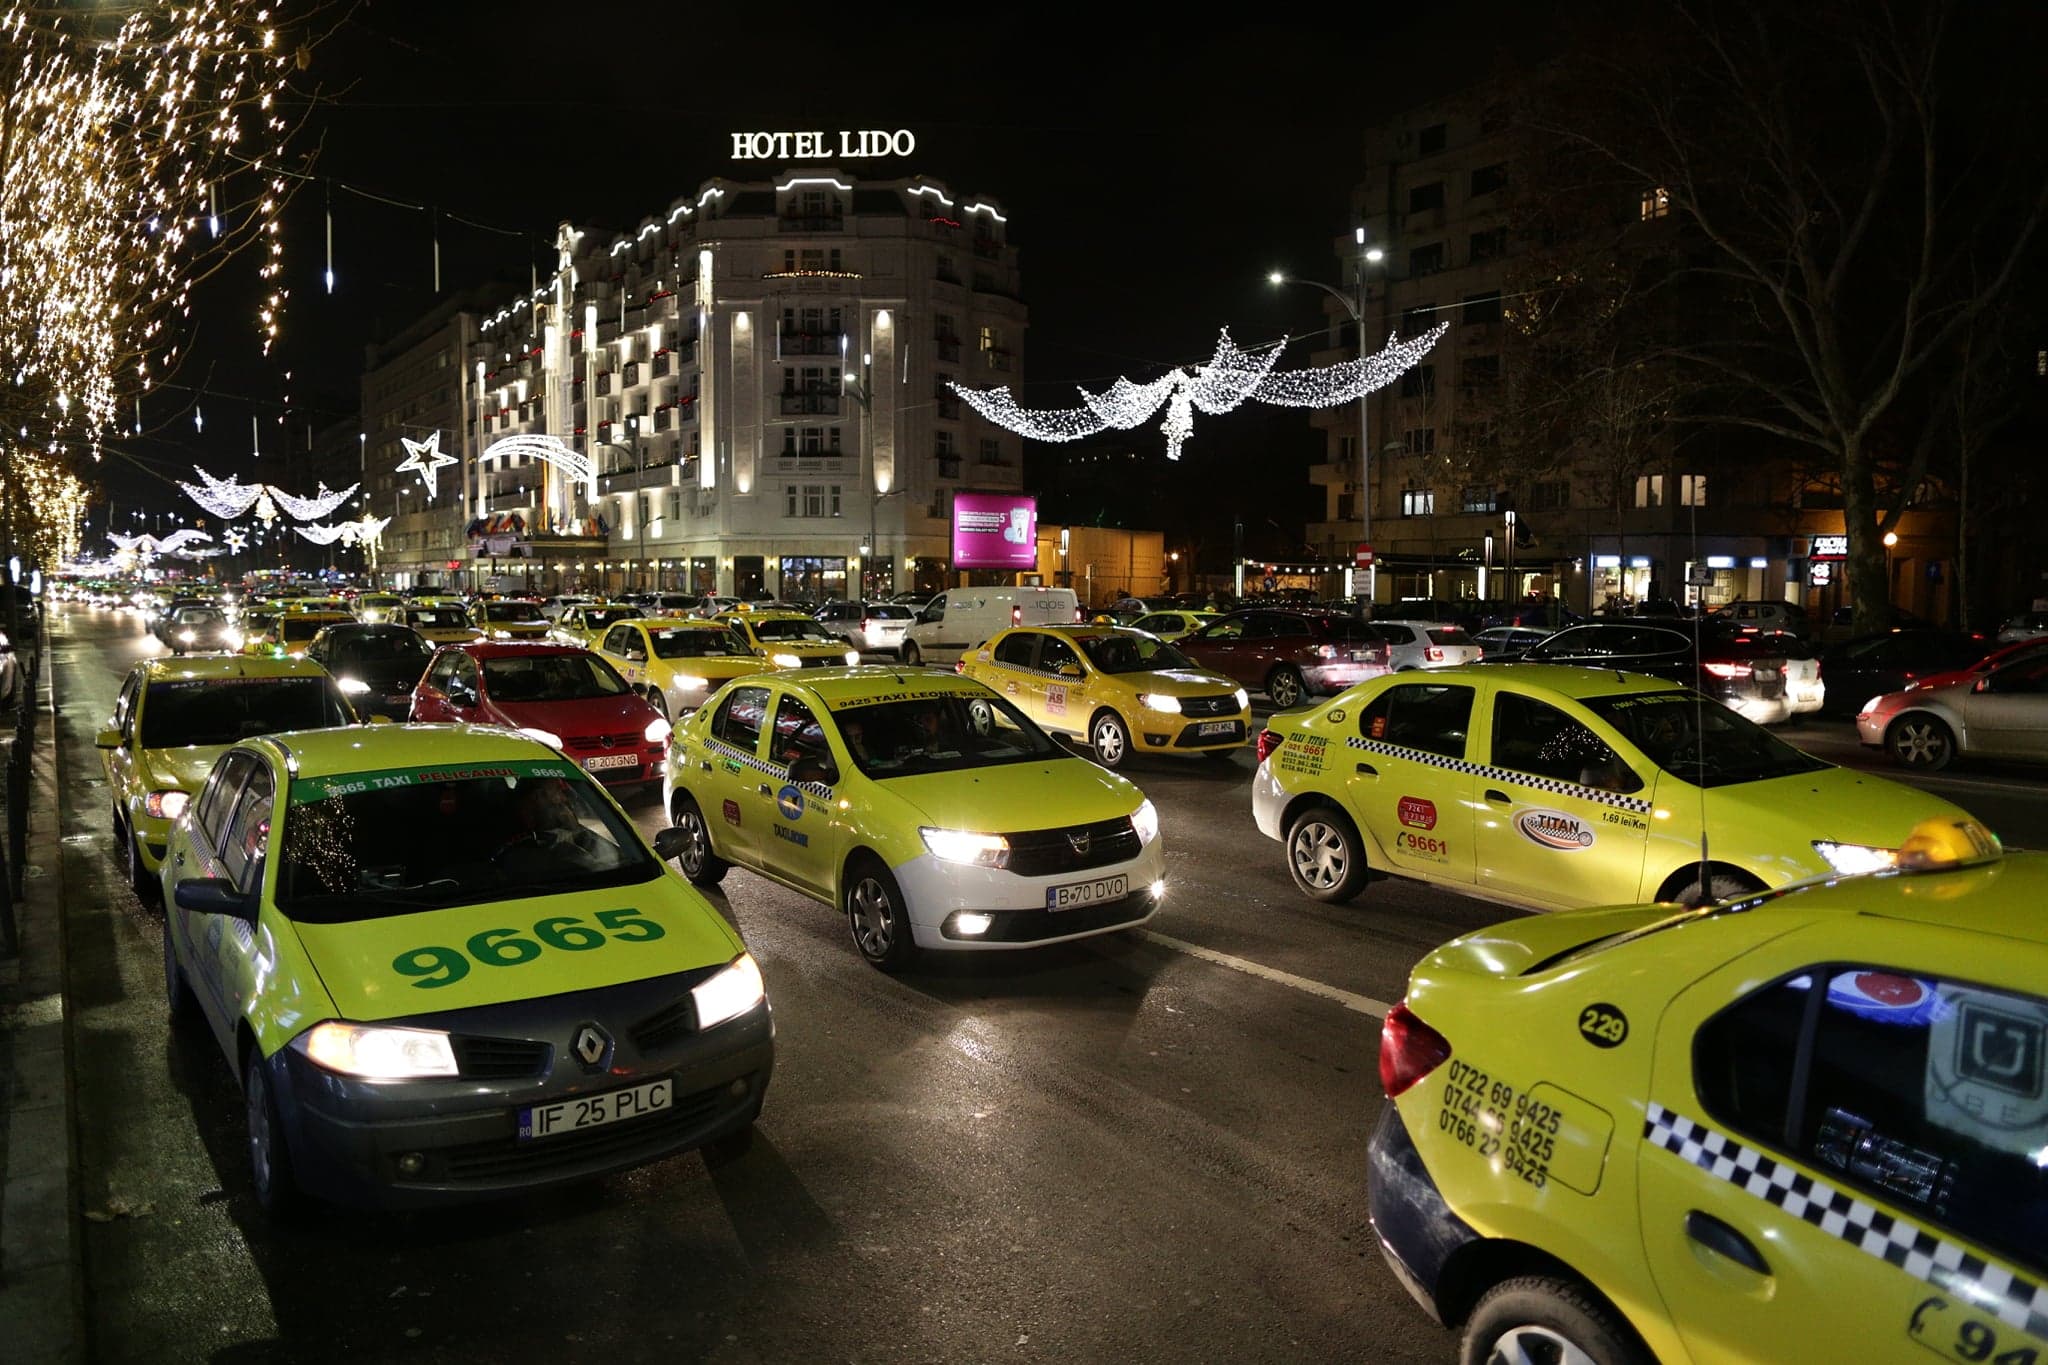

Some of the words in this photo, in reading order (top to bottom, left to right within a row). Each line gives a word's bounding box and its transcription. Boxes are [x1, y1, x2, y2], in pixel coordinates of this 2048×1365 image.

[731, 131, 833, 159] HOTEL
[839, 129, 916, 157] LIDO
[839, 697, 871, 708] 9425
[871, 692, 907, 702] TAXI
[911, 690, 956, 699] LEONE
[588, 758, 596, 769] B
[1303, 744, 1326, 757] 9661
[372, 775, 412, 789] TAXI
[418, 767, 519, 782] PELICANUL
[531, 767, 566, 778] 9665
[1538, 814, 1580, 833] TITAN
[1602, 812, 1619, 824] 1.69
[1407, 833, 1447, 856] 9661
[1059, 888, 1069, 905] B
[1074, 884, 1091, 903] 70
[1096, 878, 1123, 898] DVO
[392, 908, 666, 989] 9665
[1581, 1009, 1625, 1042] 229
[519, 1126, 532, 1137] RO
[539, 1105, 564, 1135] IF
[575, 1098, 605, 1128] 25
[616, 1083, 665, 1119] PLC
[1449, 1059, 1489, 1097] 0722
[1491, 1081, 1513, 1110] 69
[1516, 1094, 1562, 1135] 9425
[1444, 1083, 1481, 1120] 0744
[1510, 1120, 1555, 1162] 9425
[1439, 1109, 1475, 1148] 0766
[1479, 1132, 1501, 1158] 22
[1504, 1148, 1548, 1189] 9425
